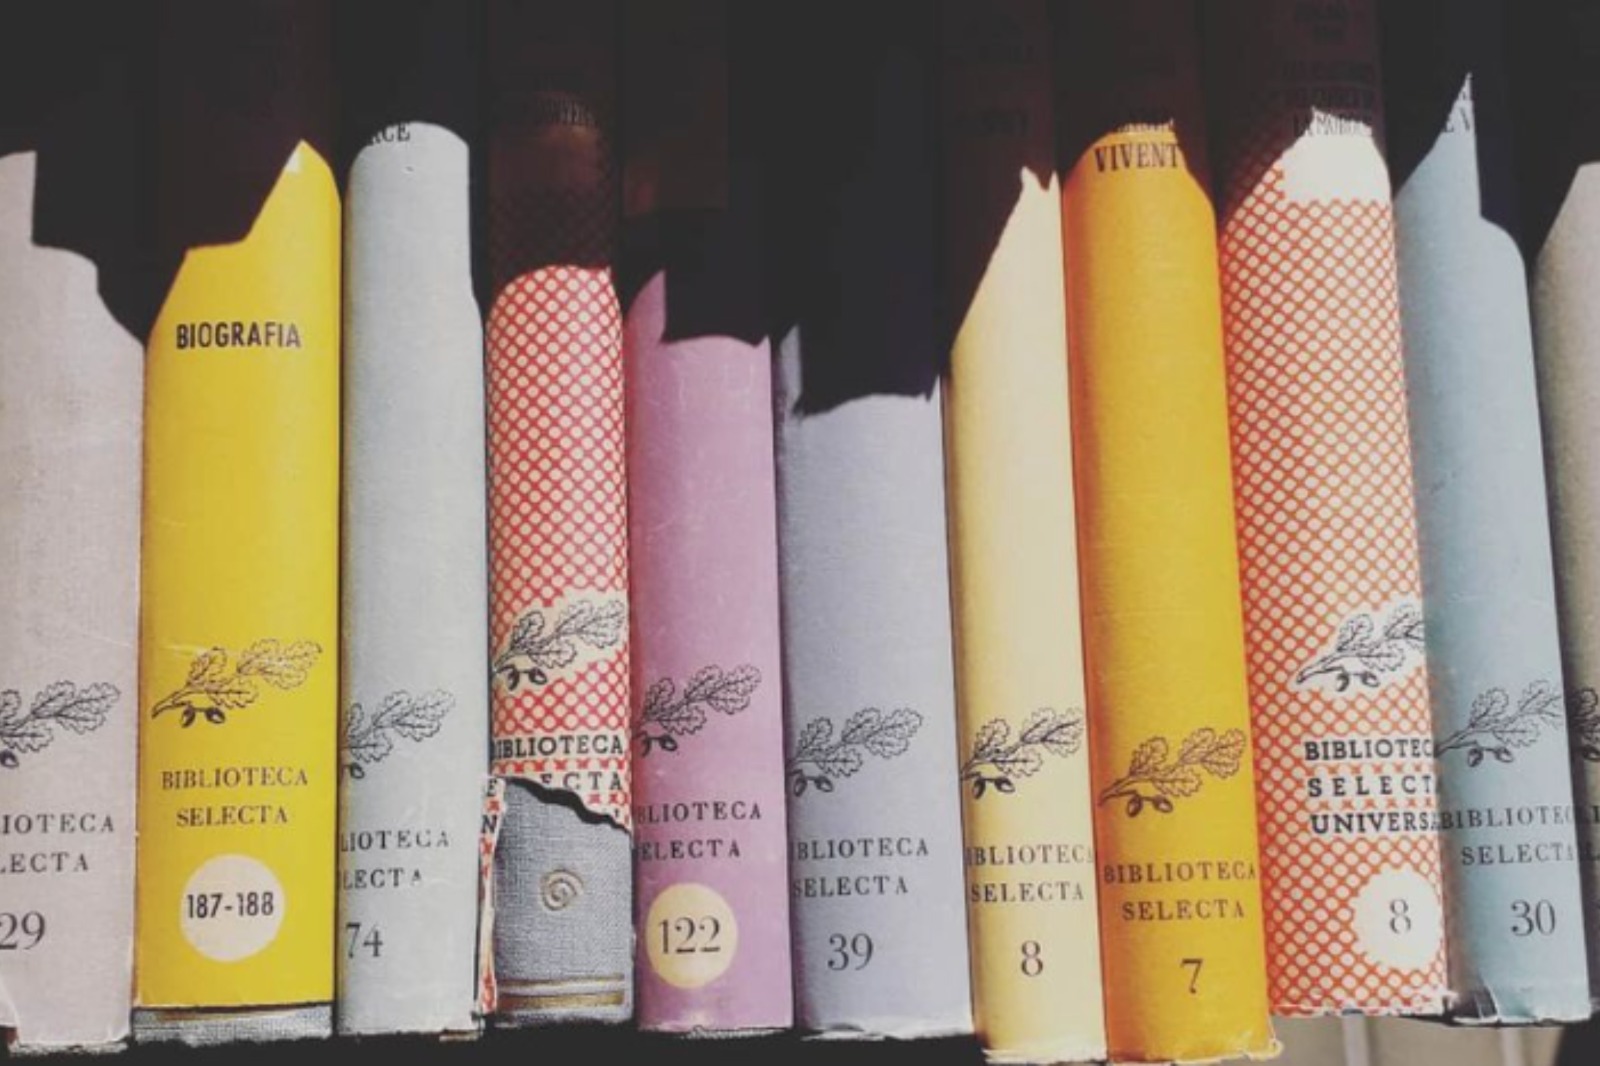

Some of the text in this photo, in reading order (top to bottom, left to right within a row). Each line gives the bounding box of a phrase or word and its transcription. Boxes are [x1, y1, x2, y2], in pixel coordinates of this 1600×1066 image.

[1094, 143, 1179, 173] VIVENT
[176, 321, 301, 350] BIOGRAFIA
[161, 766, 309, 790] BIBLIOTECA
[176, 805, 288, 828] SELECTA
[793, 875, 909, 898] SELECTA
[1104, 860, 1257, 883] BIBLIOTECA
[187, 891, 274, 918] 187-188
[971, 881, 1084, 902] SELECTA
[1122, 899, 1245, 921] SELECTA
[1389, 898, 1411, 934] 8
[1511, 899, 1556, 937] 30
[0, 910, 46, 950] 29
[345, 921, 384, 959] 74
[658, 914, 721, 955] 122
[827, 932, 874, 971] 39
[1021, 940, 1043, 977] 8
[1180, 957, 1204, 994] 7
